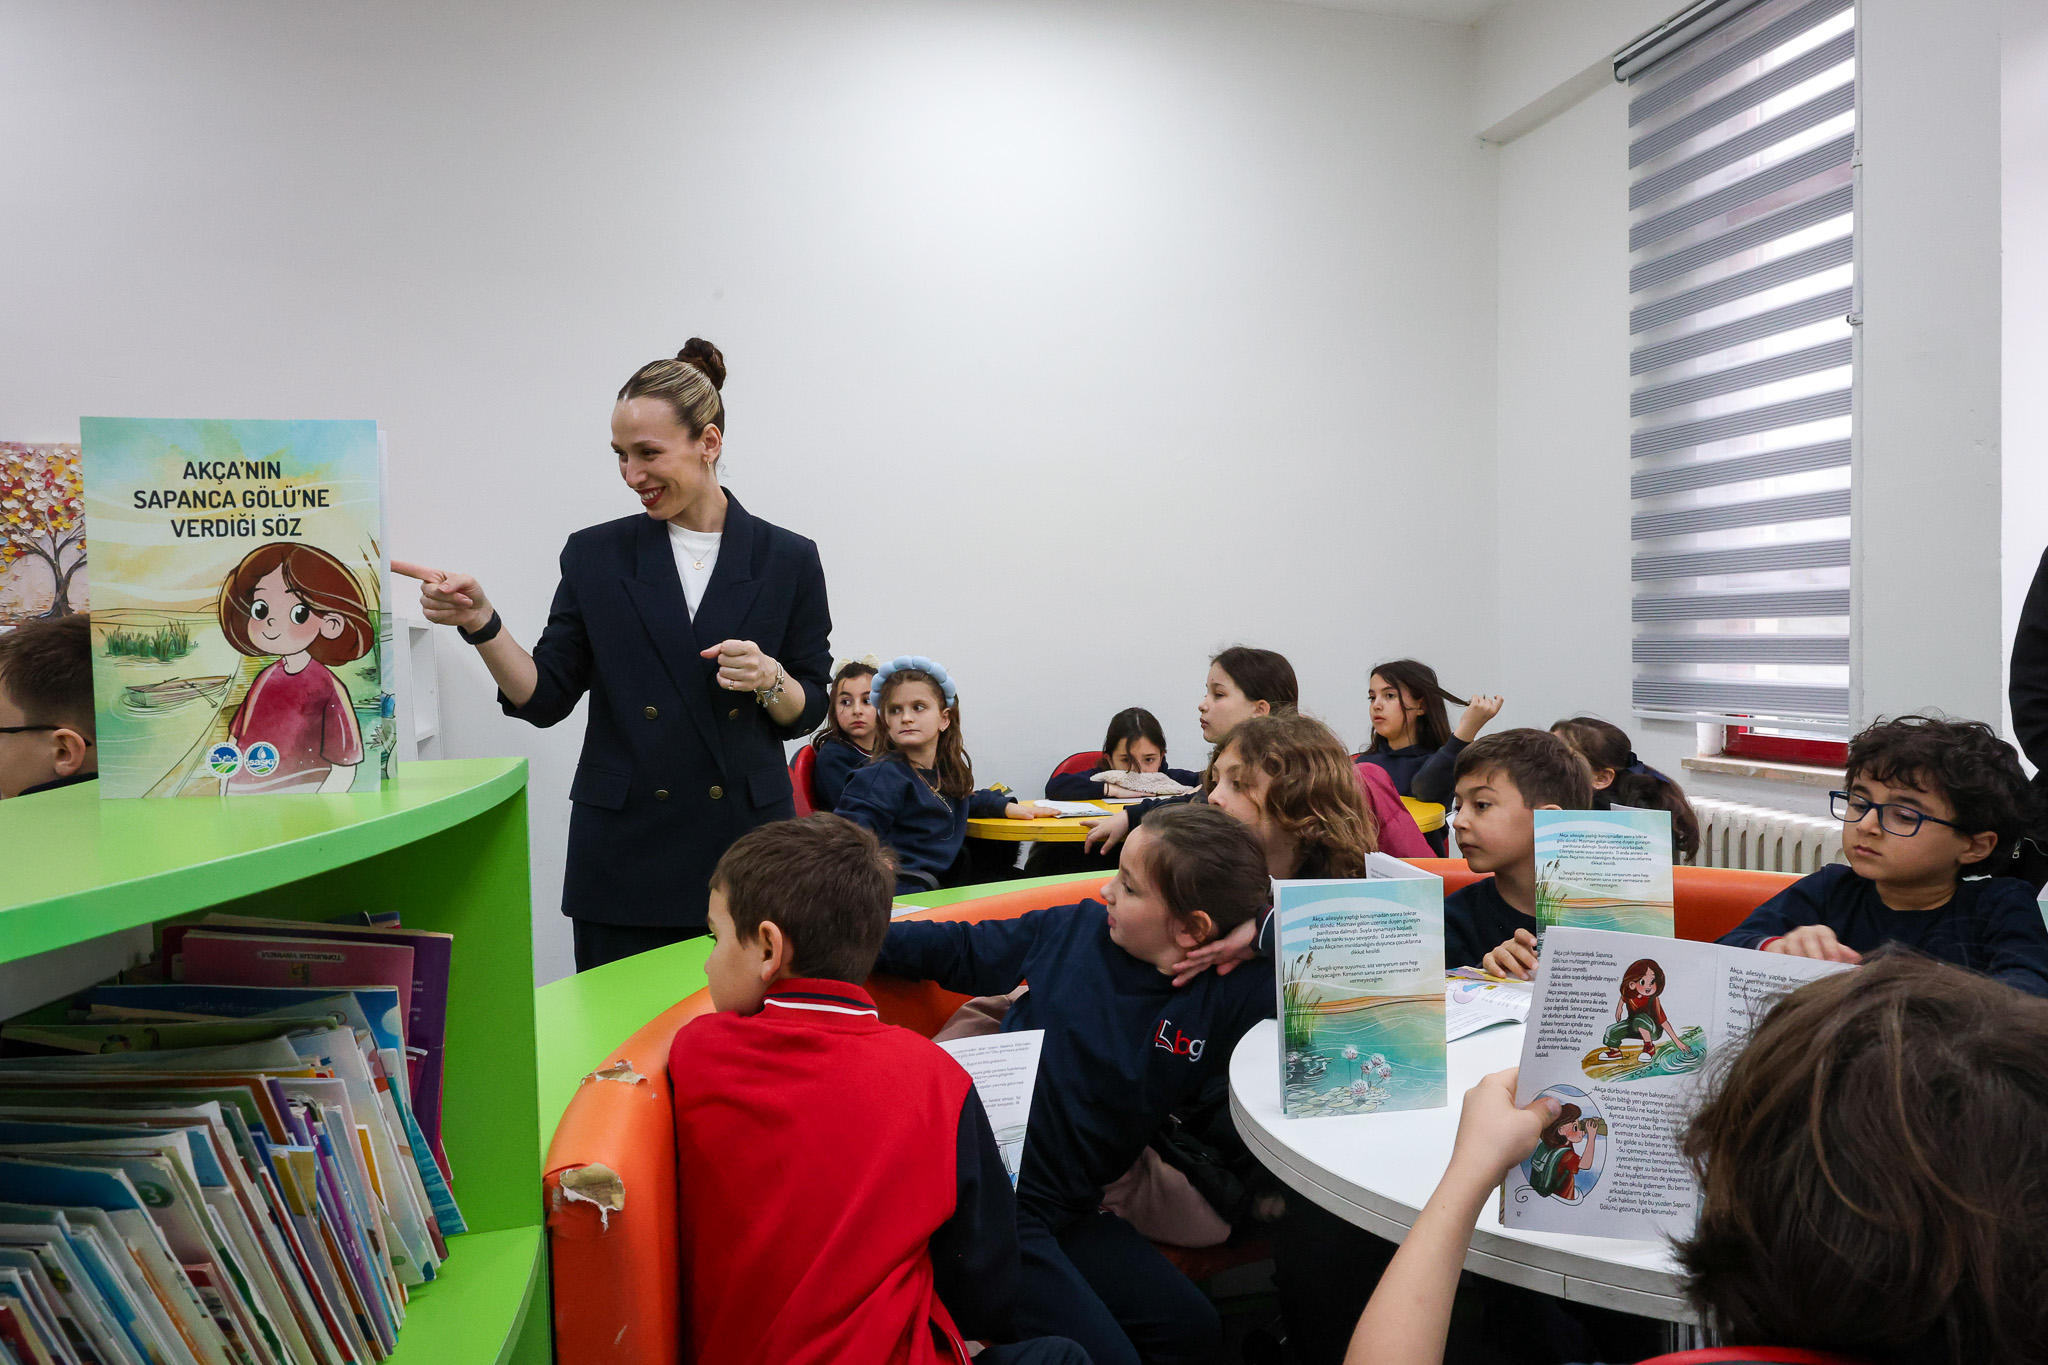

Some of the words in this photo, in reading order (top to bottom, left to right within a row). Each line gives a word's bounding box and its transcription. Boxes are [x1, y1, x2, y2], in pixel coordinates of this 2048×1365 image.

[183, 461, 281, 484] AKÇA'NIN
[134, 490, 236, 509] SAPANCA
[171, 514, 256, 538] VERDİĞİ
[262, 514, 302, 536] SÖZ
